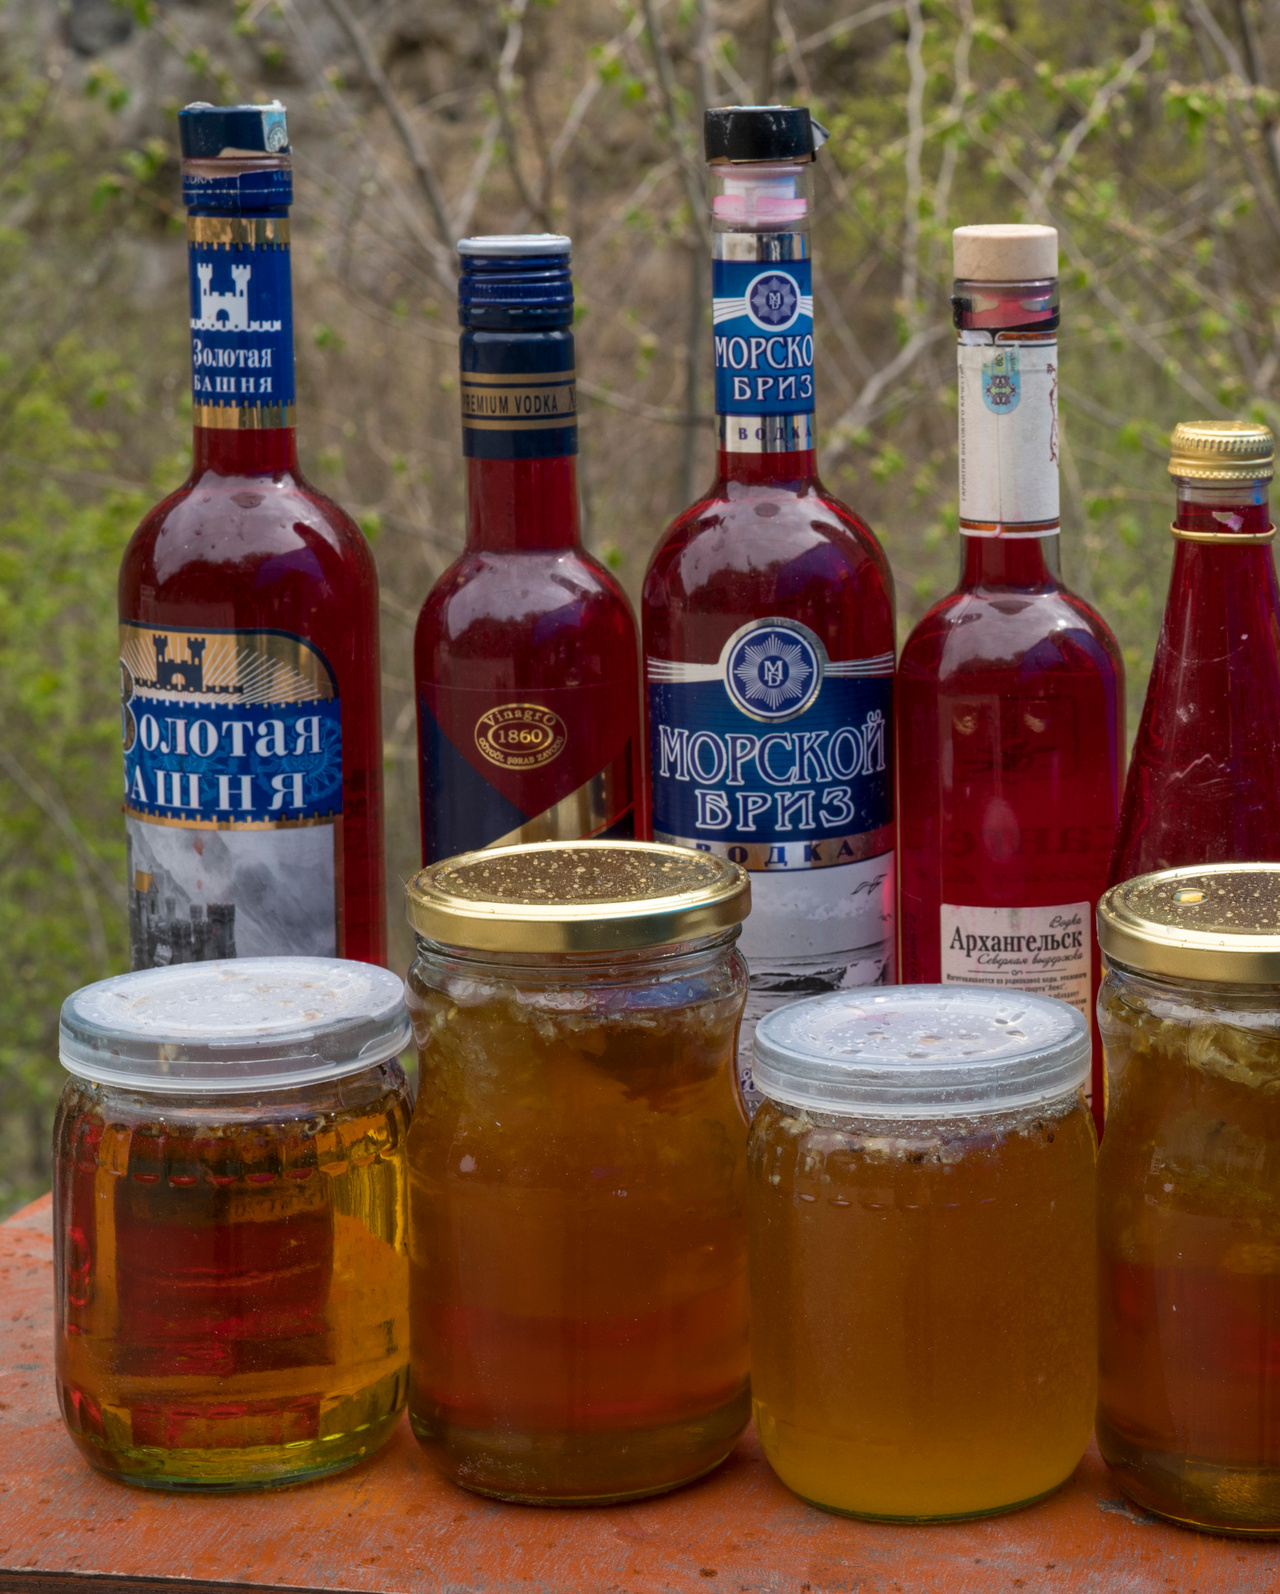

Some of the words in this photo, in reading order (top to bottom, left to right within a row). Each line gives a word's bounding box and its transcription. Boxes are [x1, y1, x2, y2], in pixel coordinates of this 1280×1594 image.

[193, 339, 272, 369] Золотая
[194, 374, 273, 393] БАШНЯ
[732, 374, 813, 401] БРИЗ
[462, 394, 509, 414] PREMIUM
[514, 394, 559, 413] VODKA
[738, 426, 812, 442] ВОДКА
[498, 729, 543, 744] 1860
[658, 709, 886, 786] МОРСКОЙ
[695, 786, 855, 831] БРИЗ
[950, 925, 1083, 958] Архангельск
